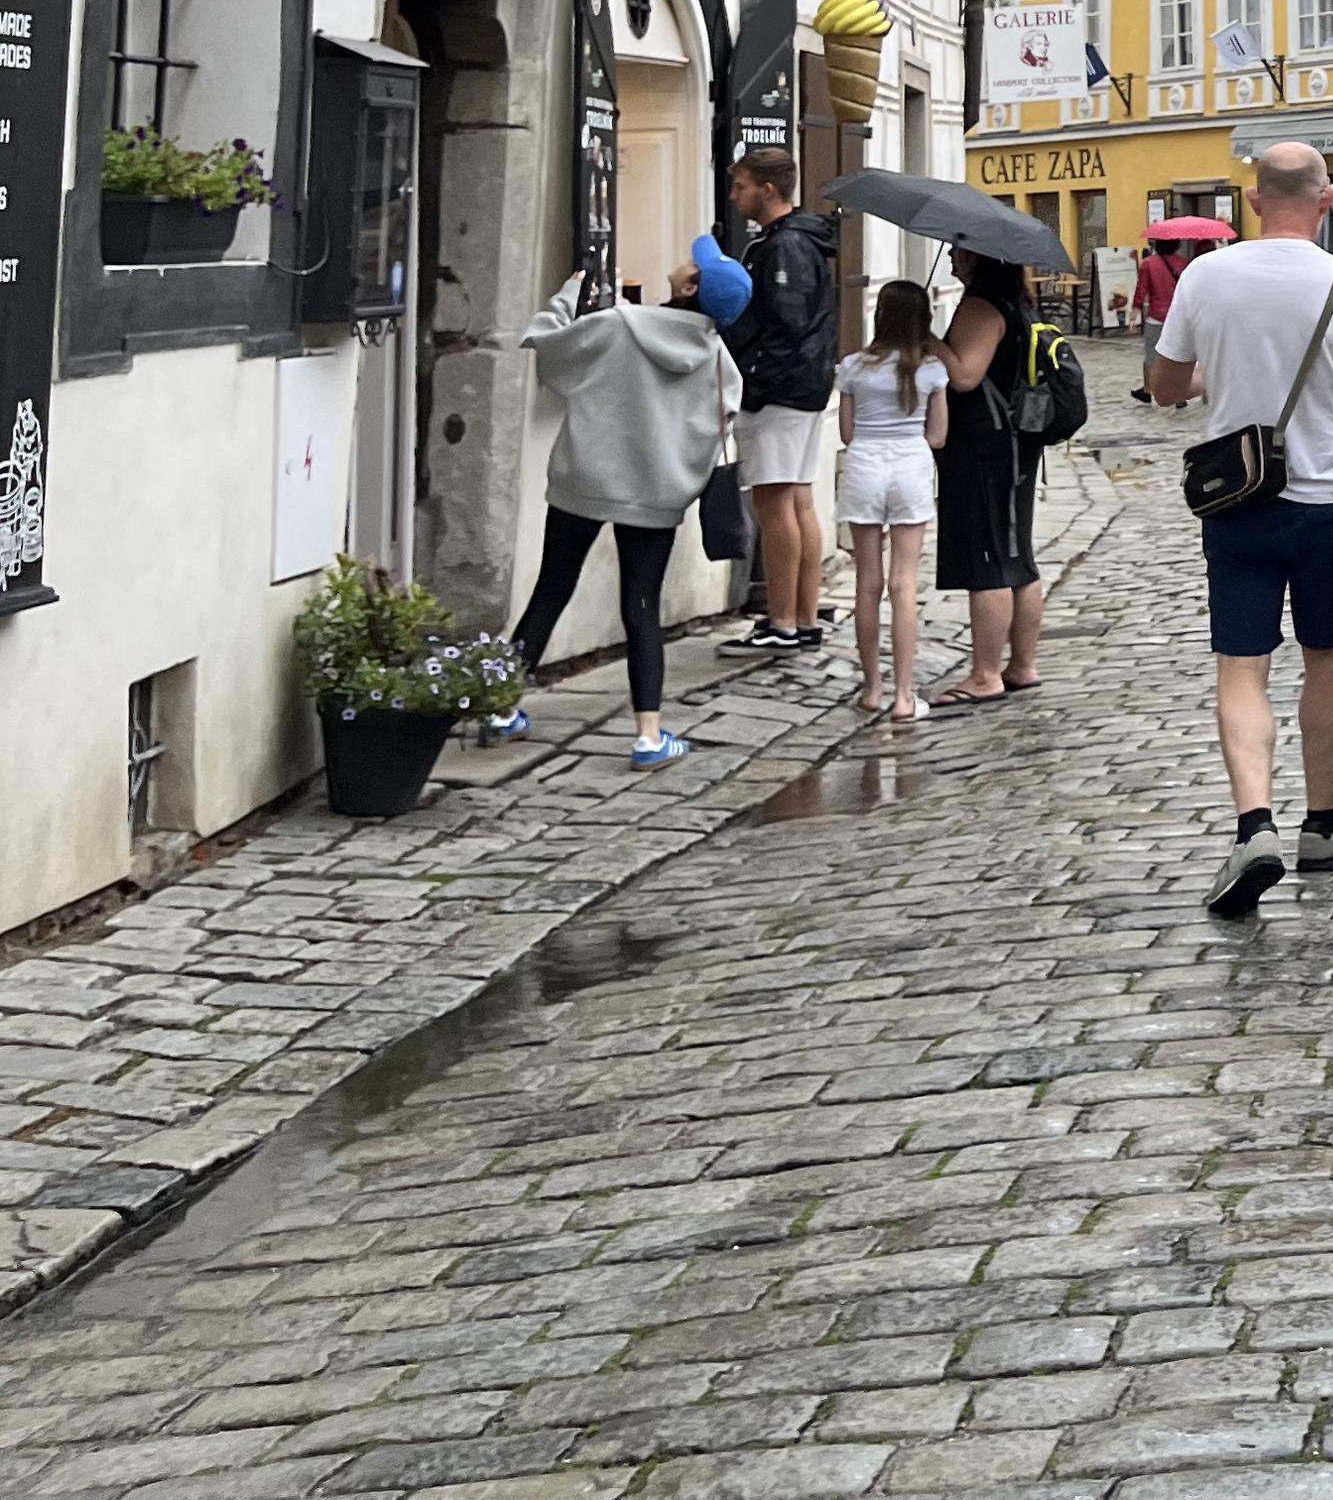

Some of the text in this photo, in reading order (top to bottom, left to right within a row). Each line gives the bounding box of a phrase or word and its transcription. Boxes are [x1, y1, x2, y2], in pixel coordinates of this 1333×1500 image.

[993, 10, 1075, 29] GALERIE
[982, 148, 1106, 184] CAFE ZAPA
